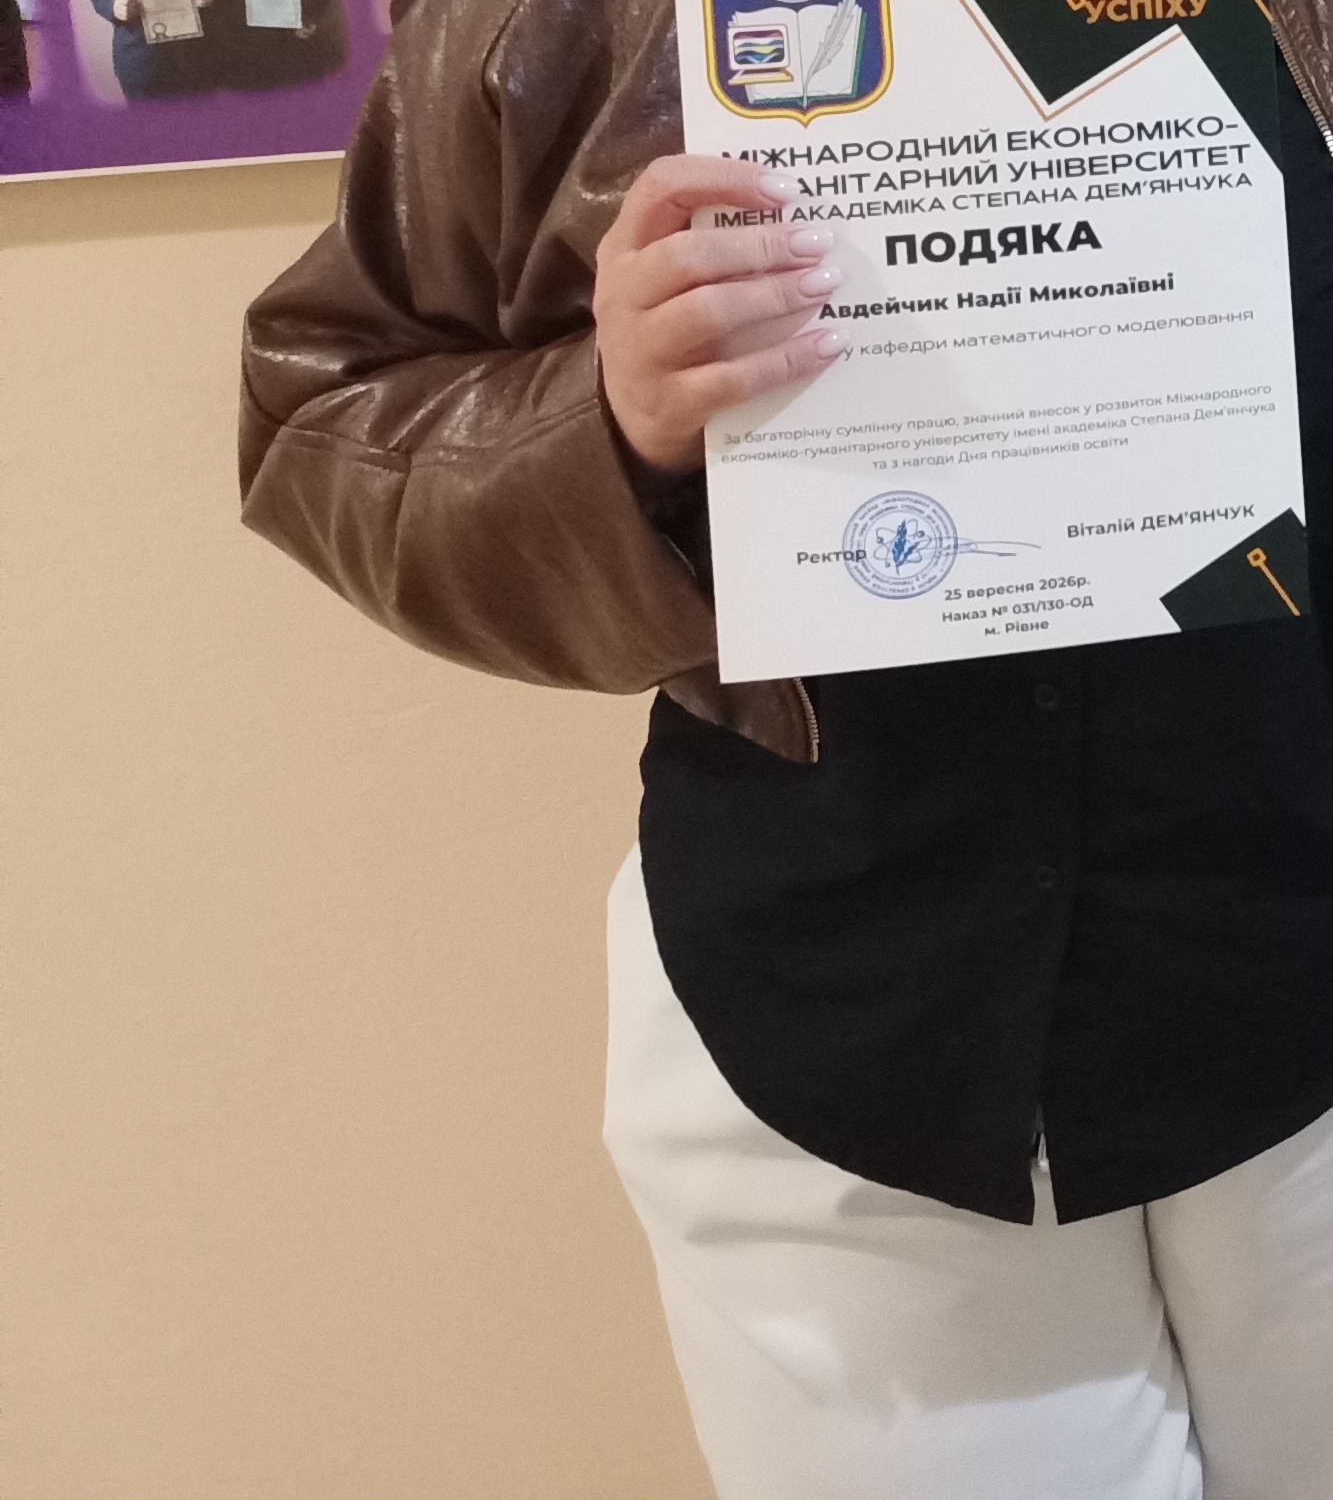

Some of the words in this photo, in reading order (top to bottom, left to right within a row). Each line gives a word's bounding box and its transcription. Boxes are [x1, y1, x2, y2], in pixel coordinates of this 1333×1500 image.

[1007, 116, 1238, 150] ЕКОНОМІКО-
[1007, 144, 1251, 182] УНІВЕРСИТЕТ
[790, 196, 946, 224] АКАДЕМІКА
[952, 187, 1077, 210] СТЕПАНА
[885, 220, 1103, 266] ПОДЯКА
[819, 295, 949, 320] Авдейчик
[957, 287, 1022, 310] Надії
[1029, 272, 1174, 303] Миколаївні
[860, 337, 947, 358] кафедри
[954, 323, 1111, 348] математичного
[1117, 309, 1255, 334] моделювання
[1067, 516, 1136, 539] Віталій
[796, 547, 867, 565] Ректор
